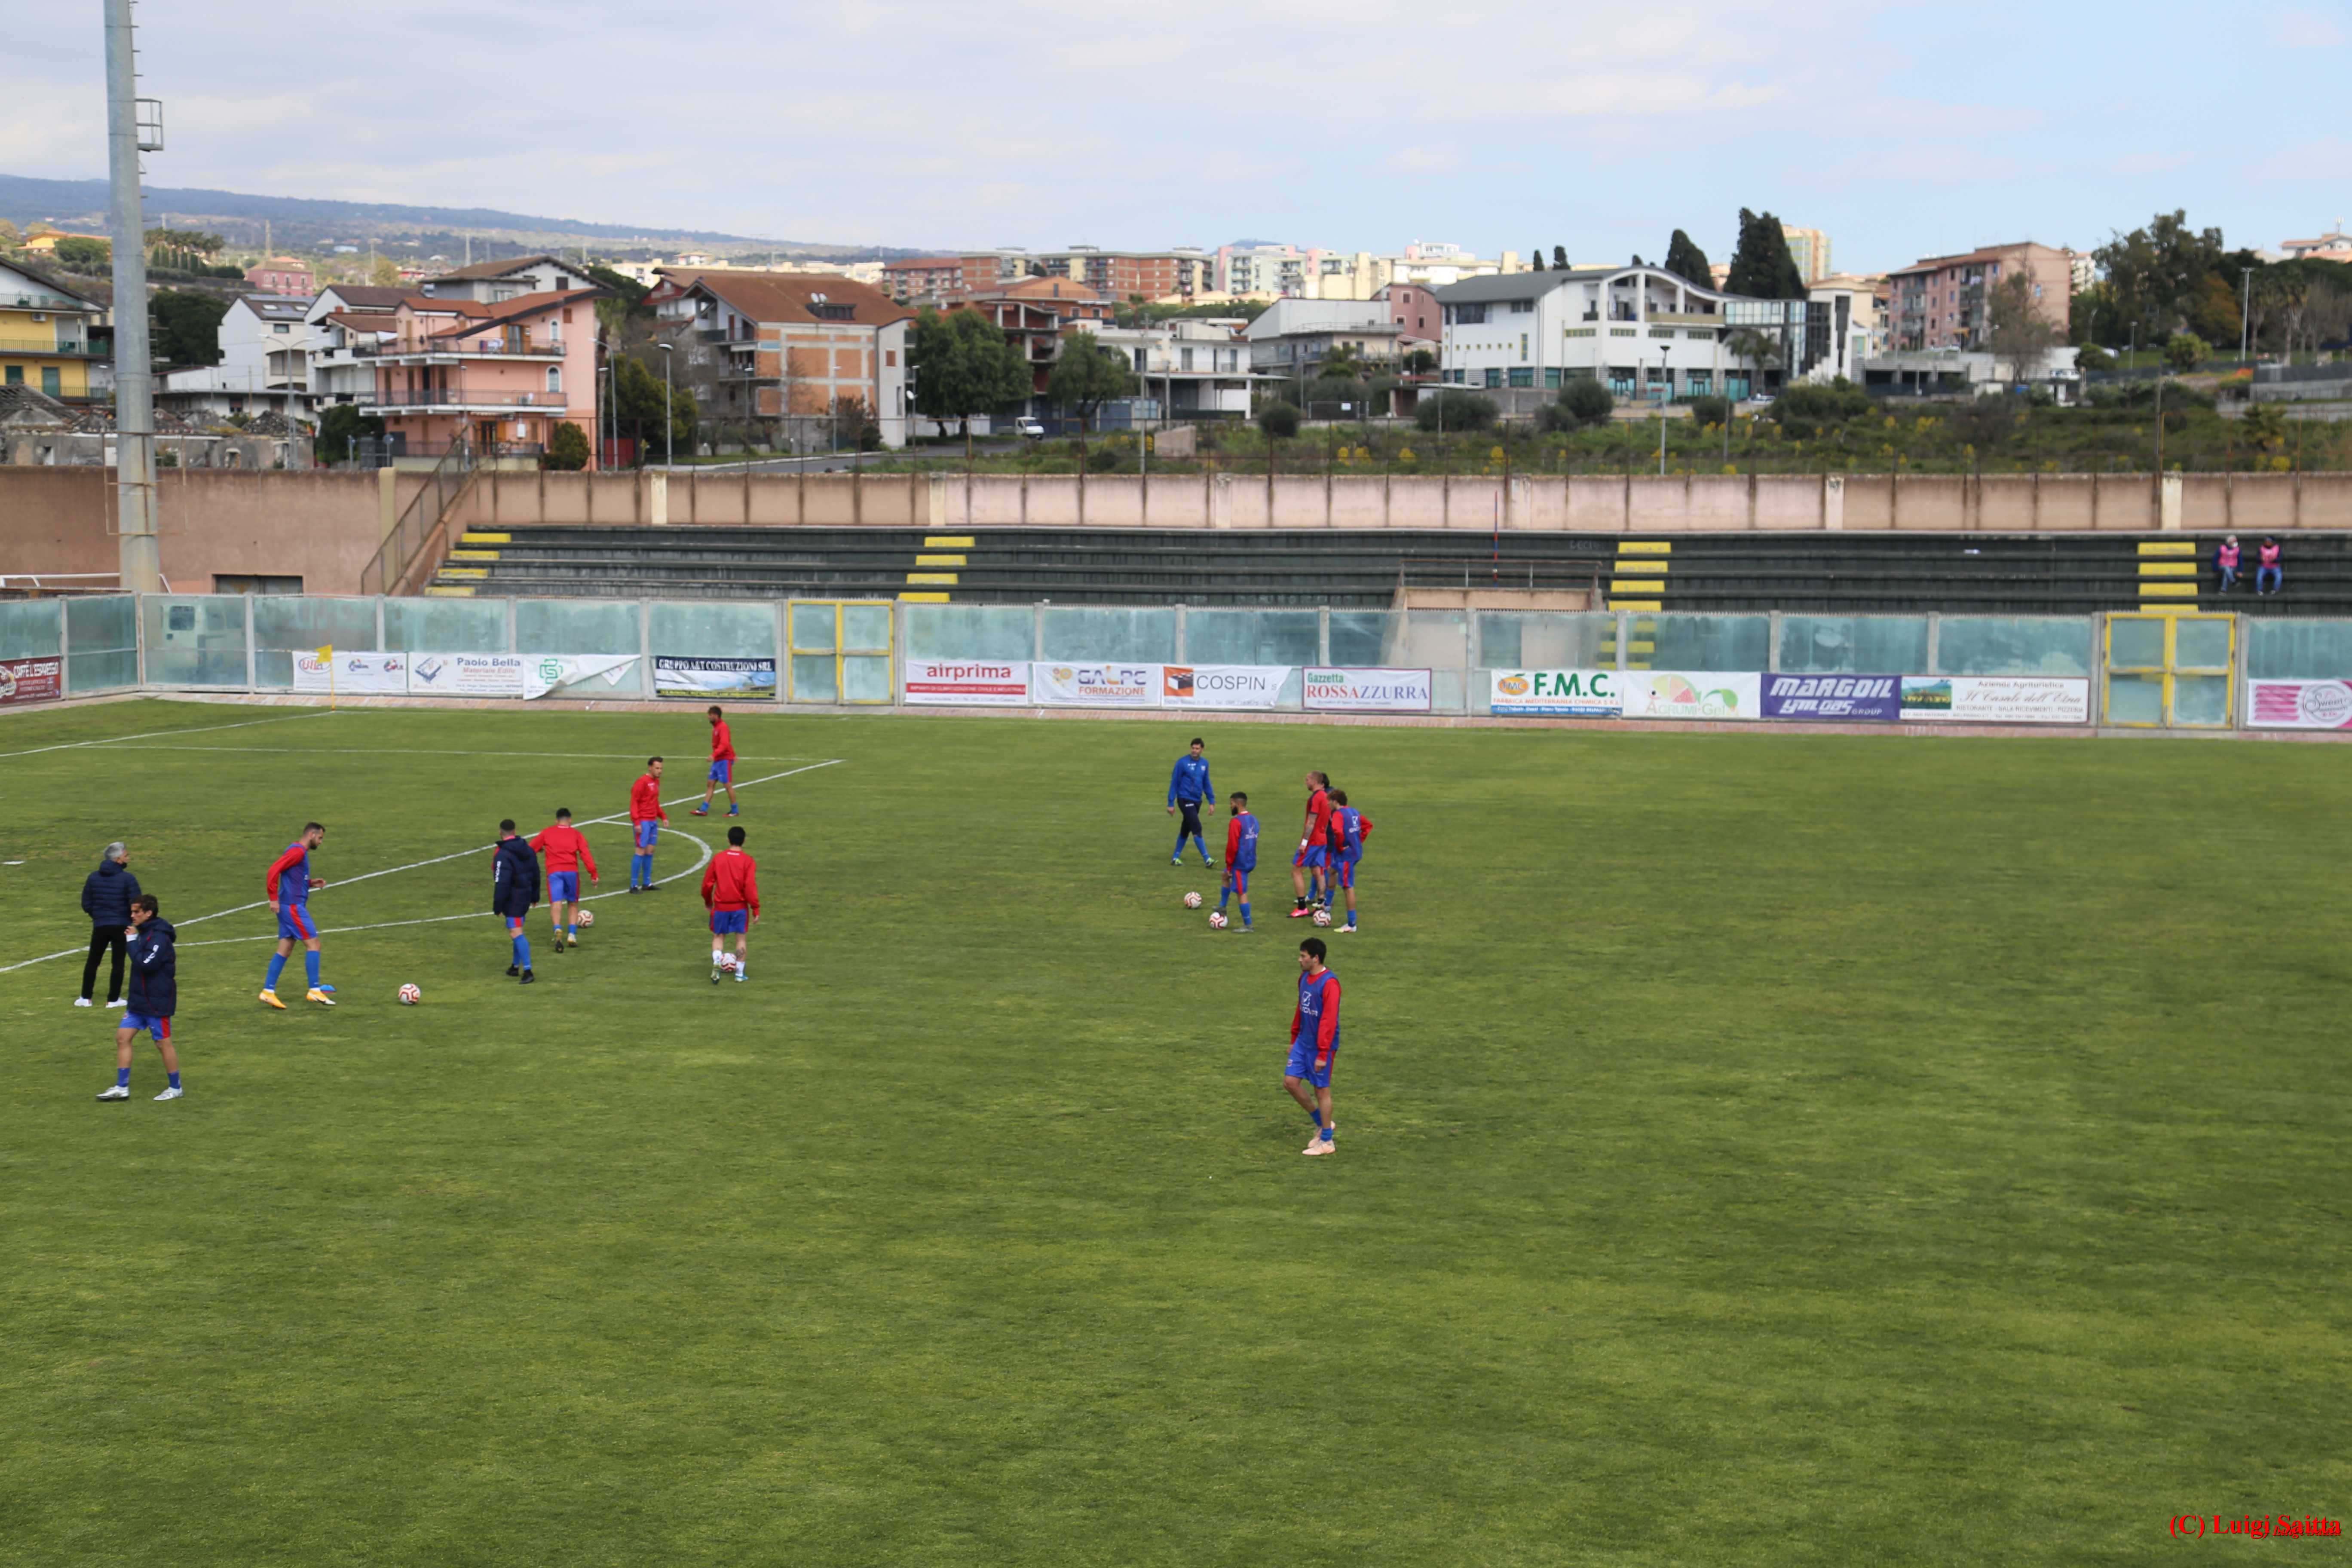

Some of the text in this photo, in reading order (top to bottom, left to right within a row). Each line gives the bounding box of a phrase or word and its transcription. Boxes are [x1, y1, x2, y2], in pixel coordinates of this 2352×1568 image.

[457, 657, 521, 666] Paolo Bella
[658, 659, 688, 670] GRUPPO
[706, 661, 757, 671] COSTRUZIONI
[758, 661, 772, 671] SRL
[927, 663, 1011, 681] airprima
[1308, 673, 1344, 683] Gazzetta
[1196, 675, 1265, 690] COSPIN
[1534, 673, 1616, 697] F.M.C.
[1770, 677, 1893, 698] MARGOIL
[1078, 686, 1145, 695] FORMAZIONE
[1307, 685, 1428, 699] ROSSAZZURRA
[1983, 690, 2021, 702] Casale
